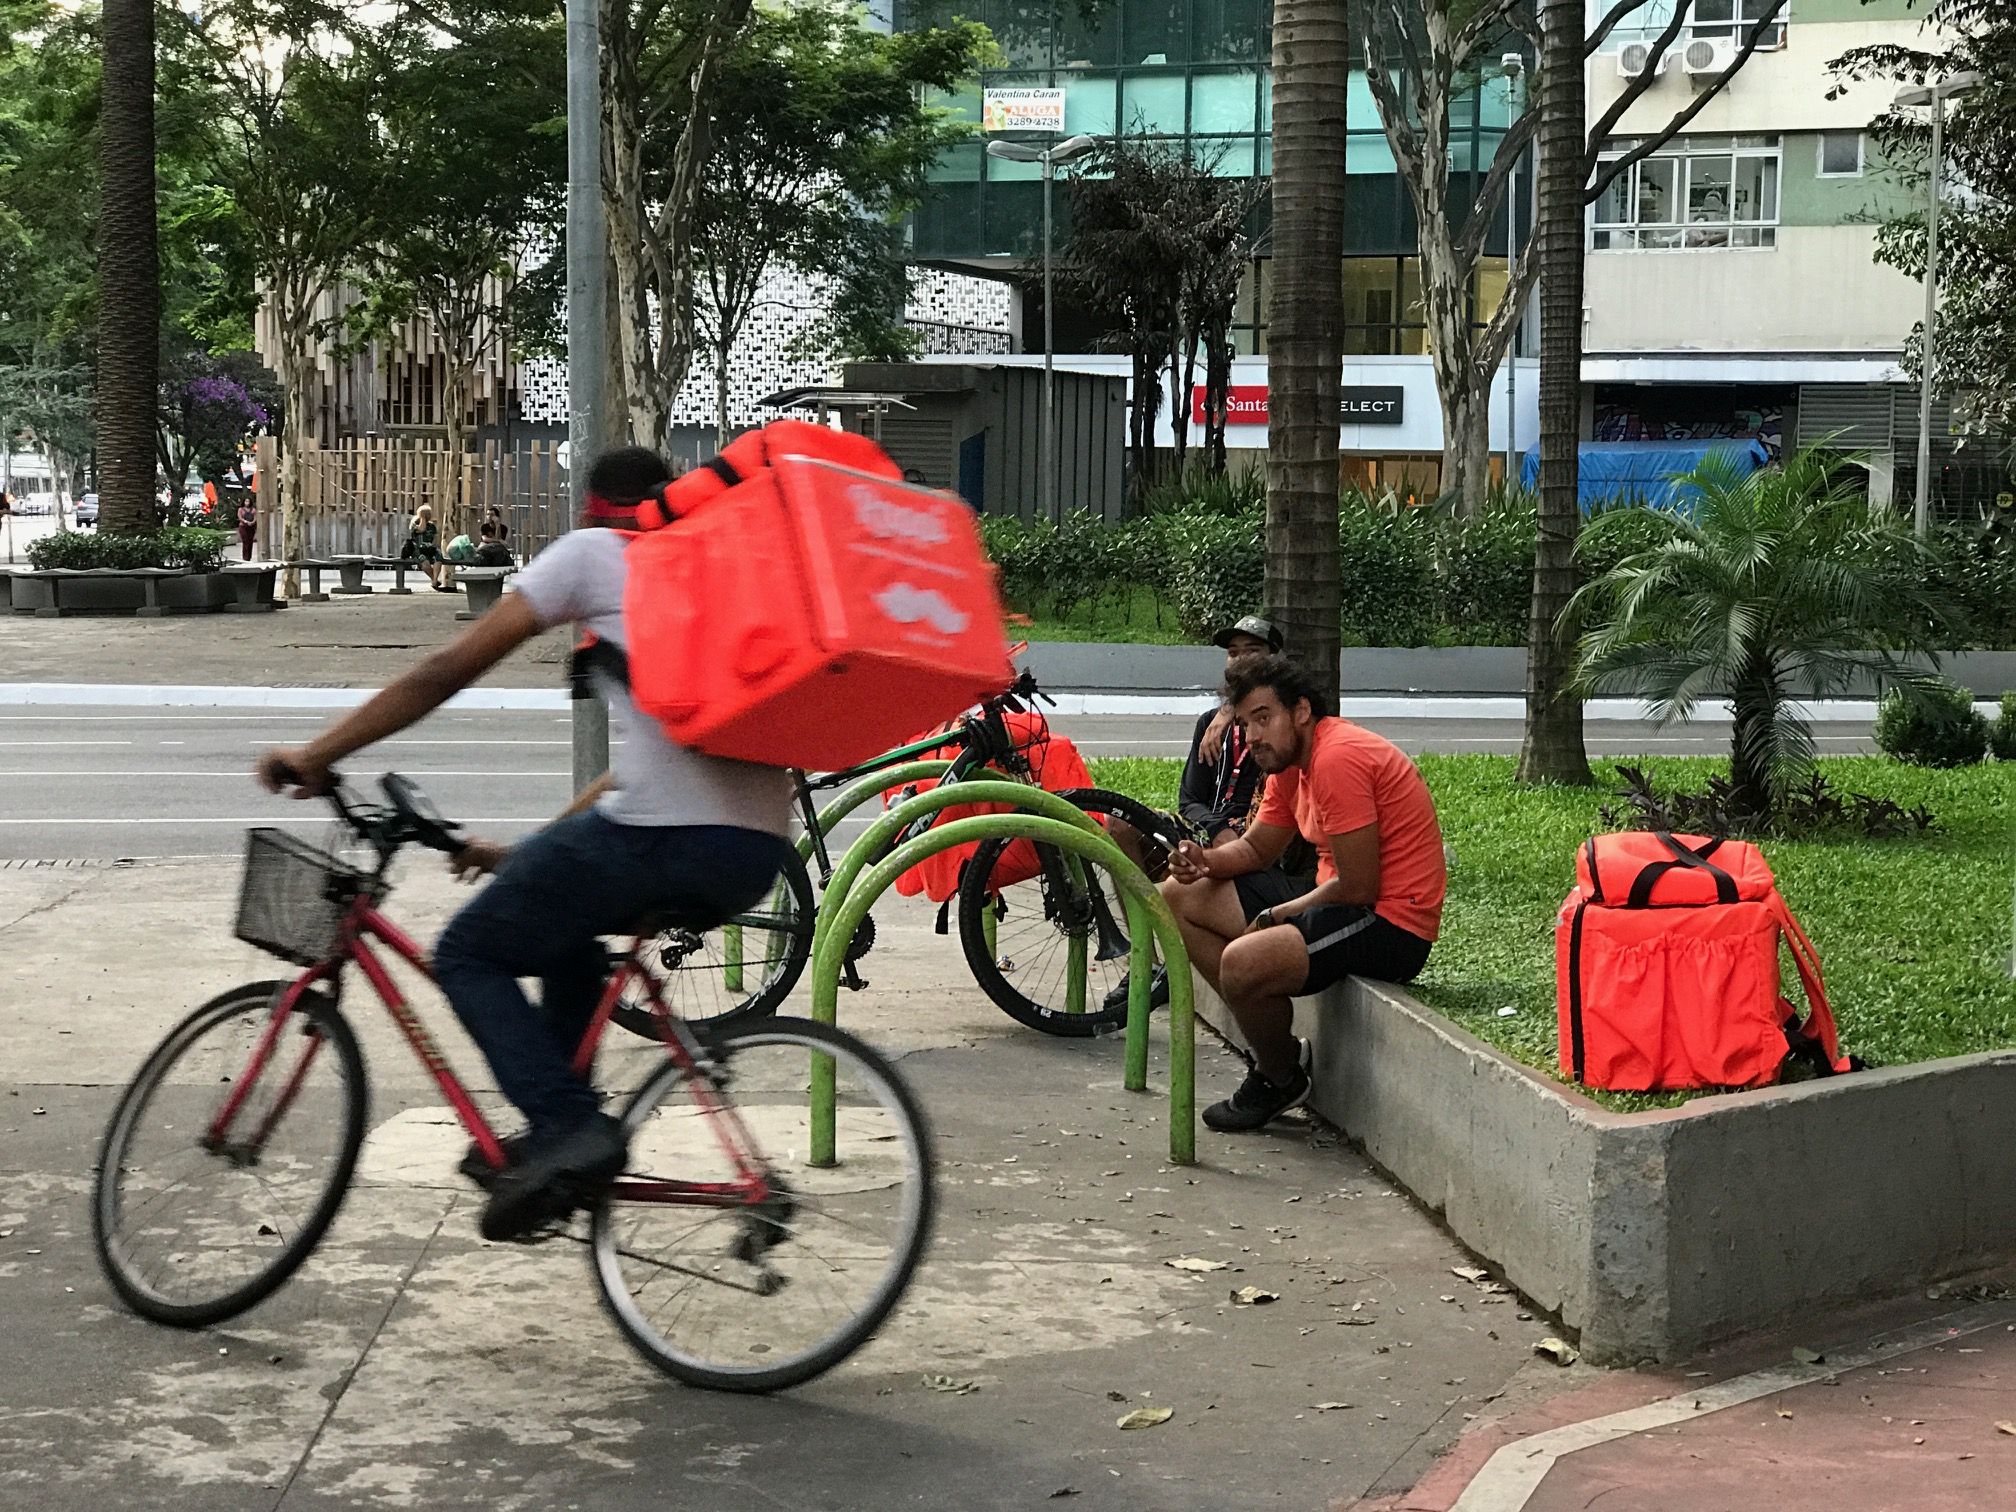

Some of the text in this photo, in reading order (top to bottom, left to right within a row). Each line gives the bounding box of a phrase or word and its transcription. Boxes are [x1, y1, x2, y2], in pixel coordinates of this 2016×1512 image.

[987, 89, 1060, 98] Valentina Caran
[1226, 395, 1268, 412] Santa
[1340, 401, 1395, 411] ELECT
